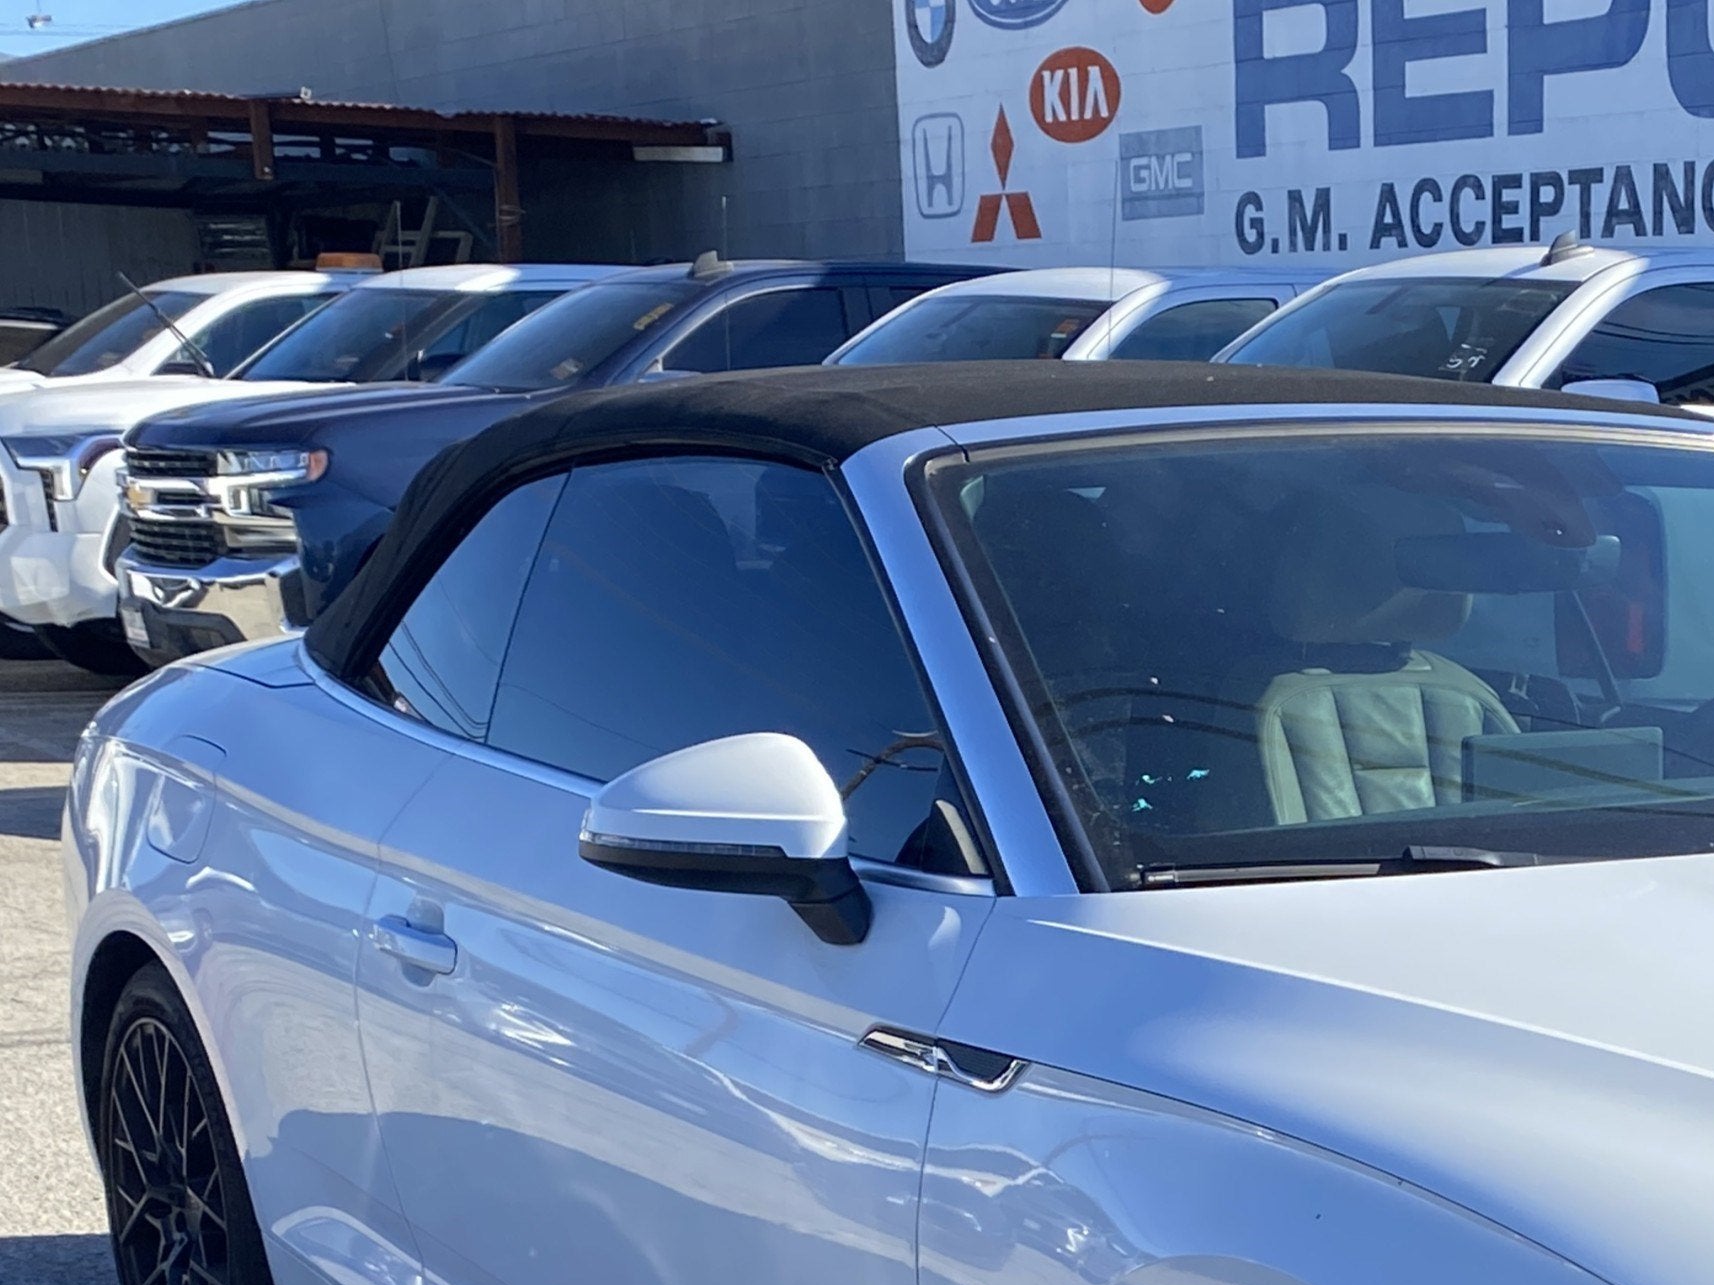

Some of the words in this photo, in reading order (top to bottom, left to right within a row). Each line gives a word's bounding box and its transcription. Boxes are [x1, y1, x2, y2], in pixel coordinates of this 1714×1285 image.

[1041, 65, 1109, 124] KIA
[1129, 151, 1194, 193] GMC
[1235, 186, 1348, 255] G.M.
